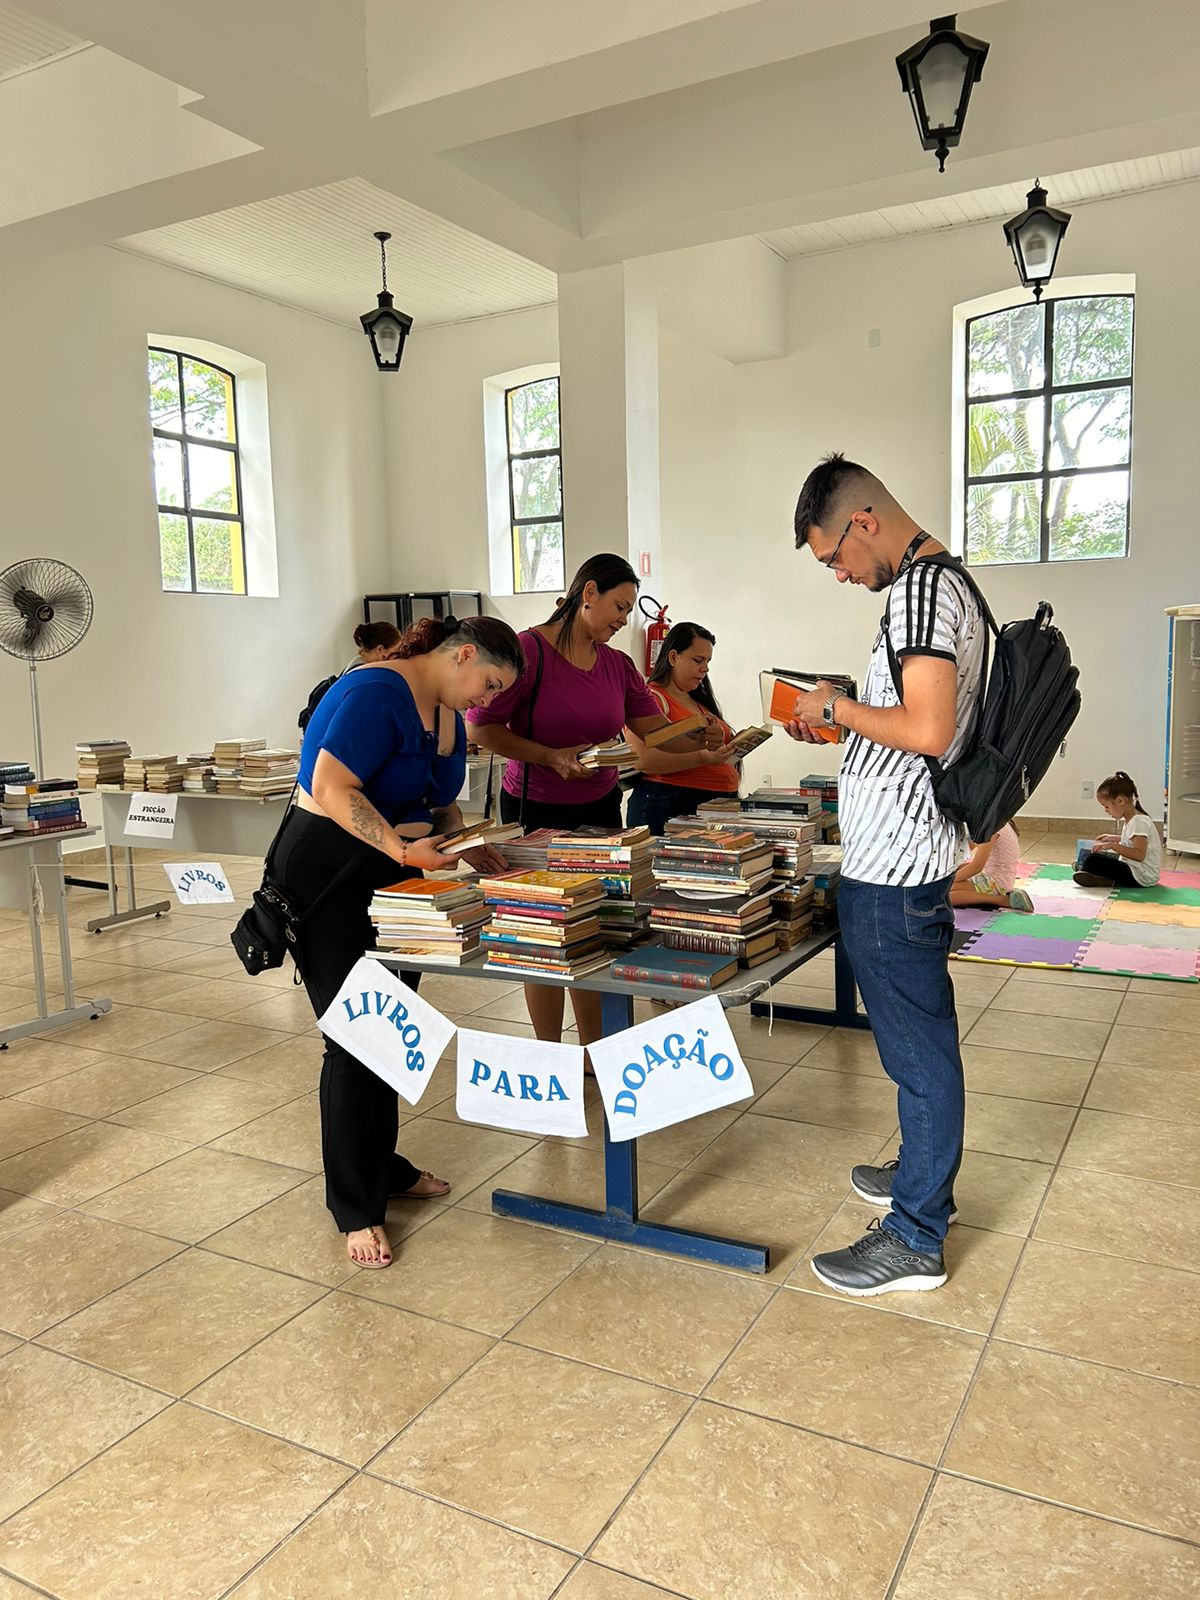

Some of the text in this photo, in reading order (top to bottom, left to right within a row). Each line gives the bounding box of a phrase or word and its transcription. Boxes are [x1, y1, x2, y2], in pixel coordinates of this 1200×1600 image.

[142, 805, 166, 814] FICÇÃO
[128, 814, 175, 824] ESTRANGEIRA
[178, 868, 226, 893] LIVROS
[342, 991, 735, 1118] LIVROS PARA DOAÇÃO
